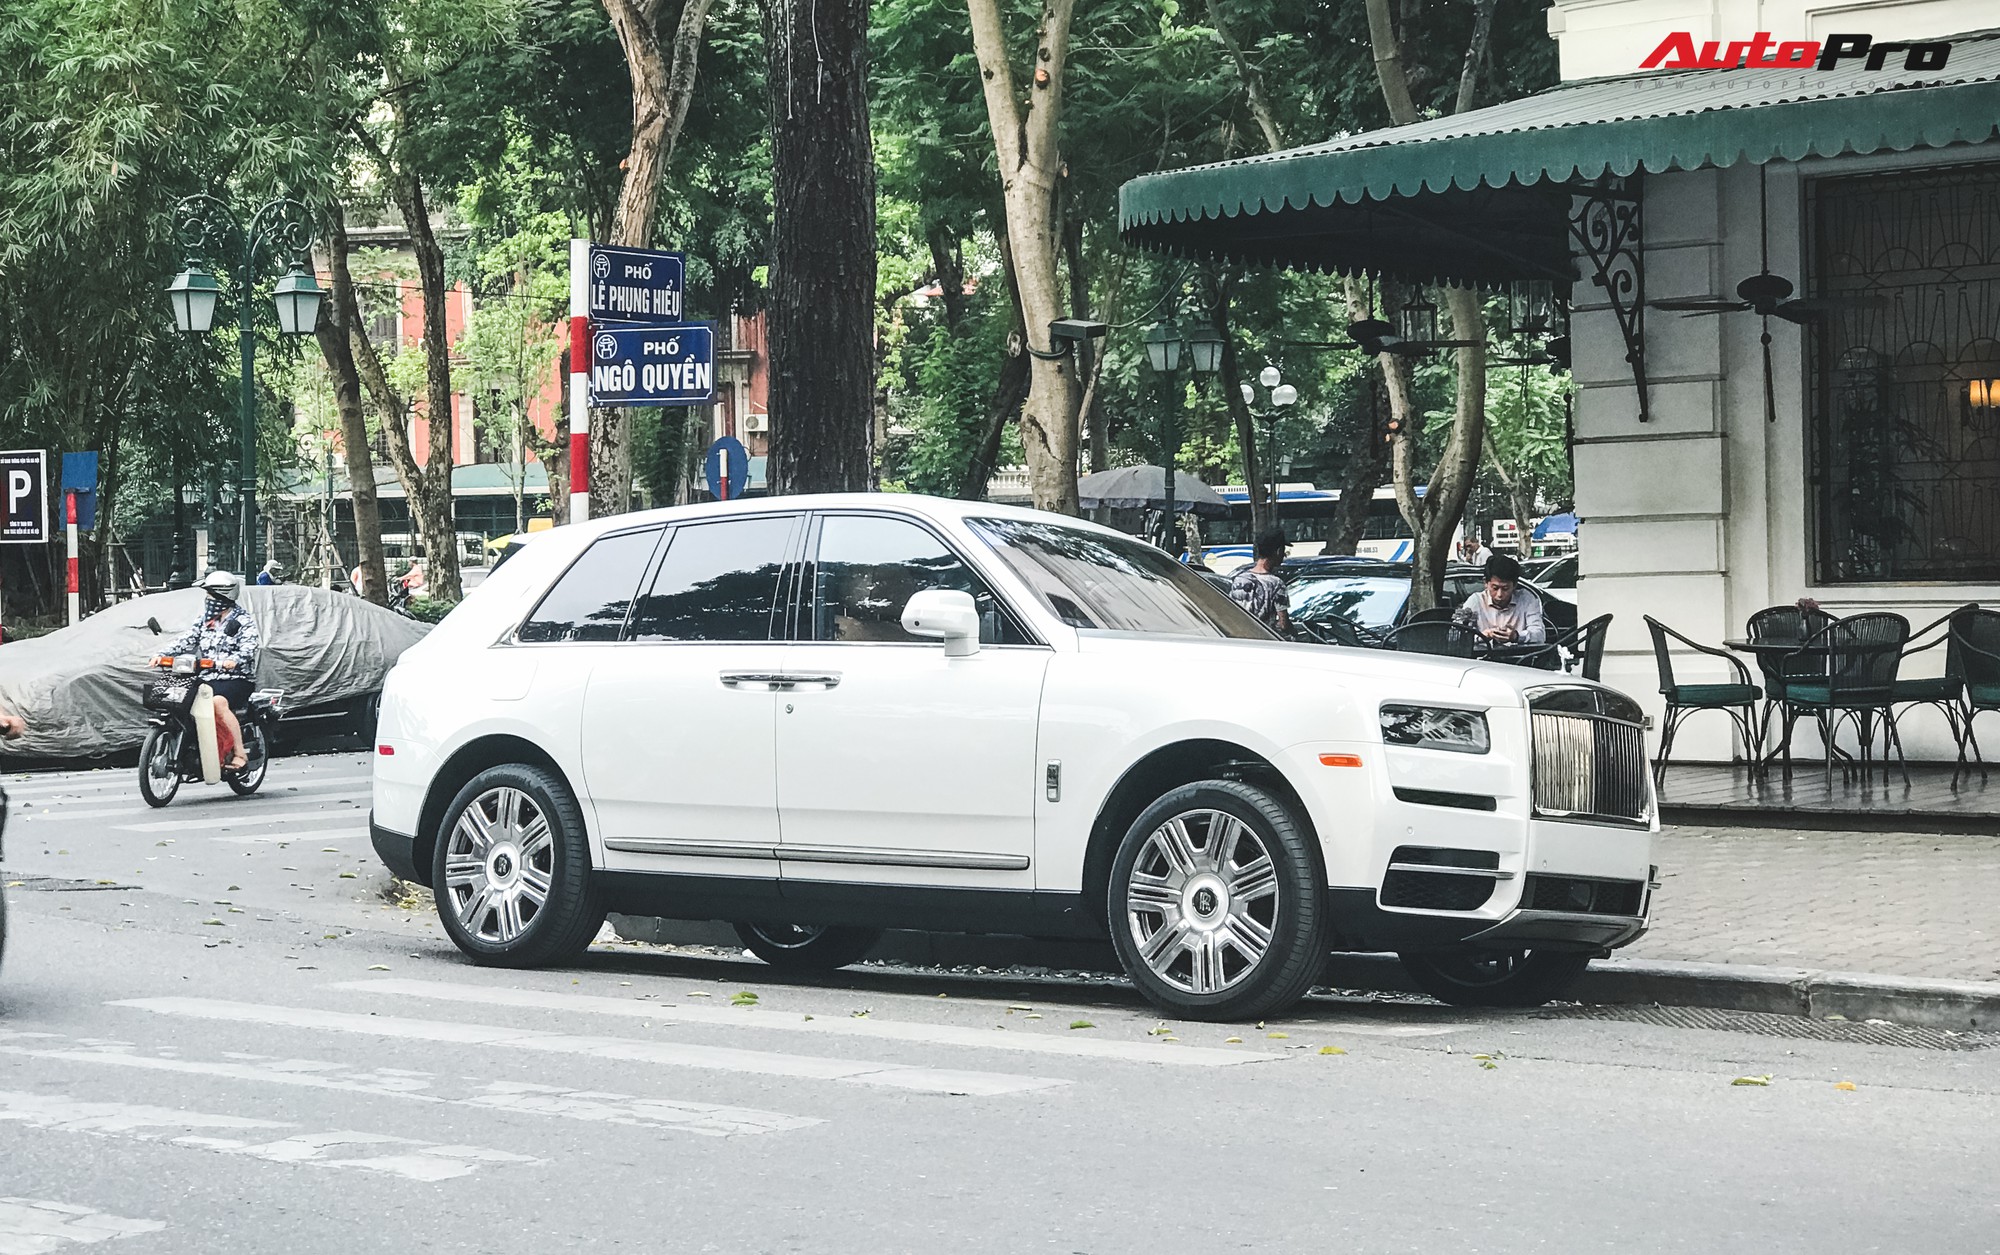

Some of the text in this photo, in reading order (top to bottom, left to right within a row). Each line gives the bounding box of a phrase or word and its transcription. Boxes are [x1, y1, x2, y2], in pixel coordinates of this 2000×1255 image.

[624, 262, 653, 280] PHỐ
[592, 279, 680, 318] LÊ PHỤNG HIỂU
[643, 335, 680, 356] PHỐ
[594, 354, 710, 393] NGÔ QUYỀN
[9, 470, 32, 514] P
